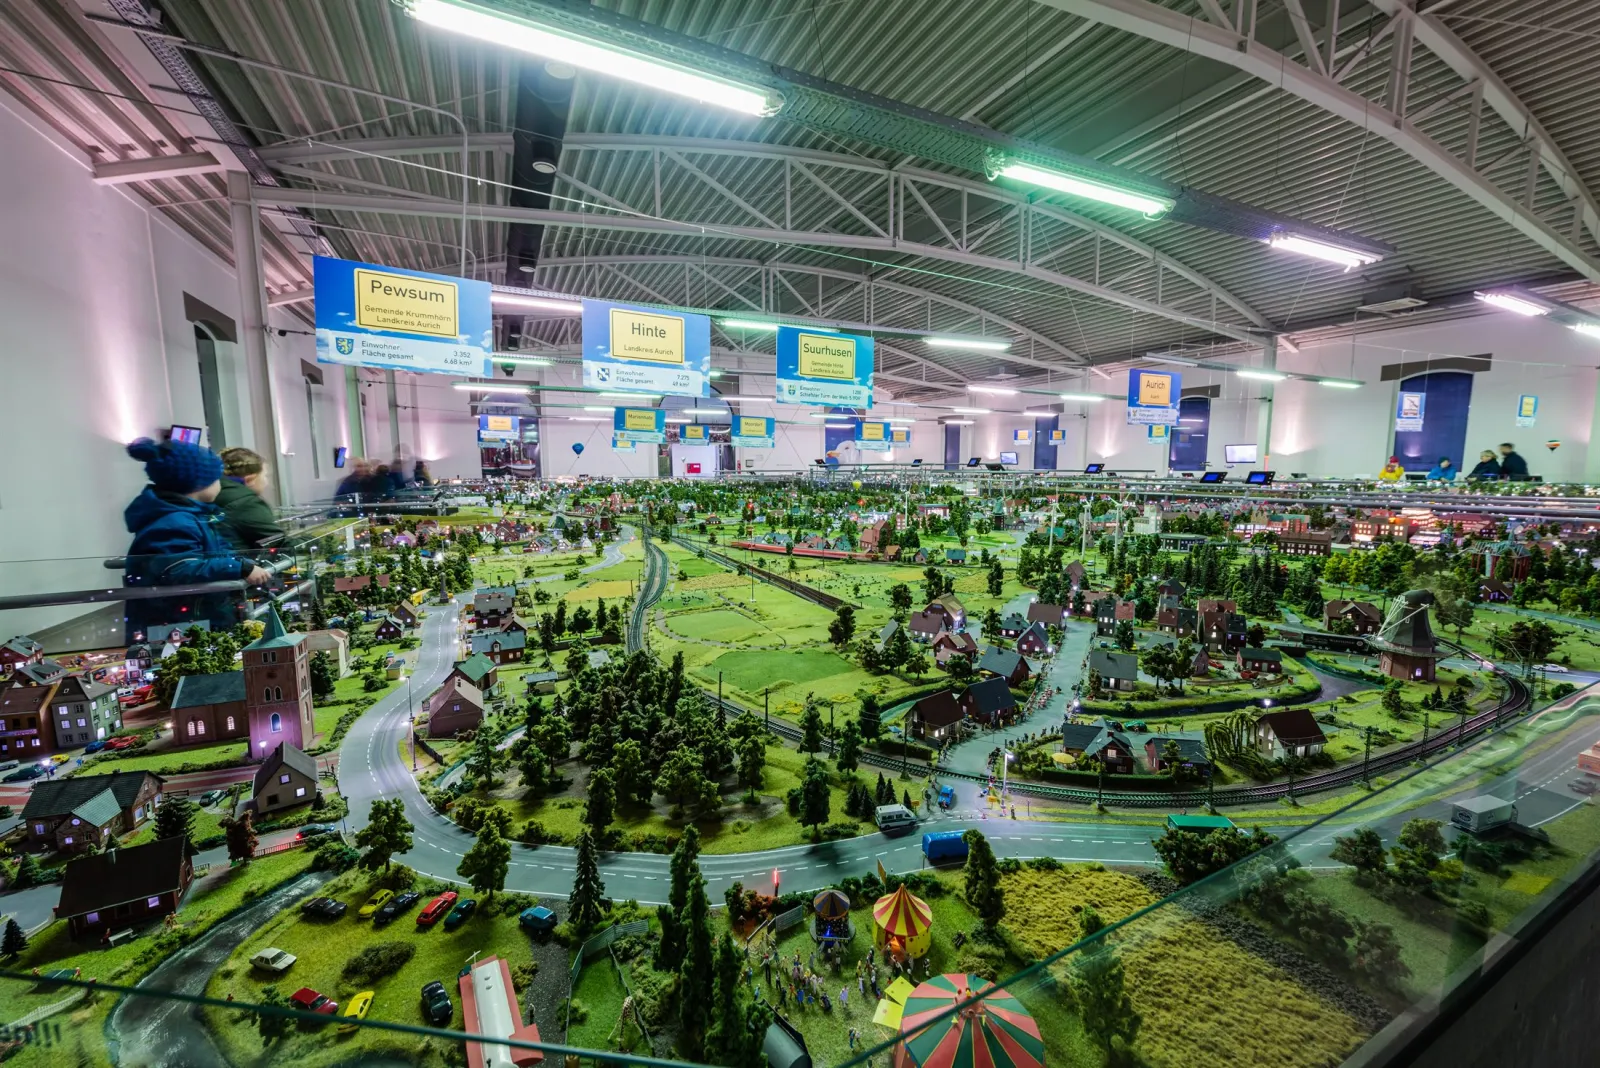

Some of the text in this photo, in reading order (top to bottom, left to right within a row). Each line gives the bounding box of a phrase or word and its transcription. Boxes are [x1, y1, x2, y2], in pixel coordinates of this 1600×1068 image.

[371, 279, 445, 303] Pewsum
[364, 304, 452, 322] Gemeinde Krummhörn
[377, 315, 441, 330] Landkreis Aurich
[631, 322, 667, 338] Hinte
[361, 350, 414, 361] Fläche gesamt
[453, 350, 471, 358] 3.352
[624, 345, 674, 356] Landkreis Aurich
[803, 343, 852, 357] Suurhusen
[1146, 380, 1165, 389] Aurich
